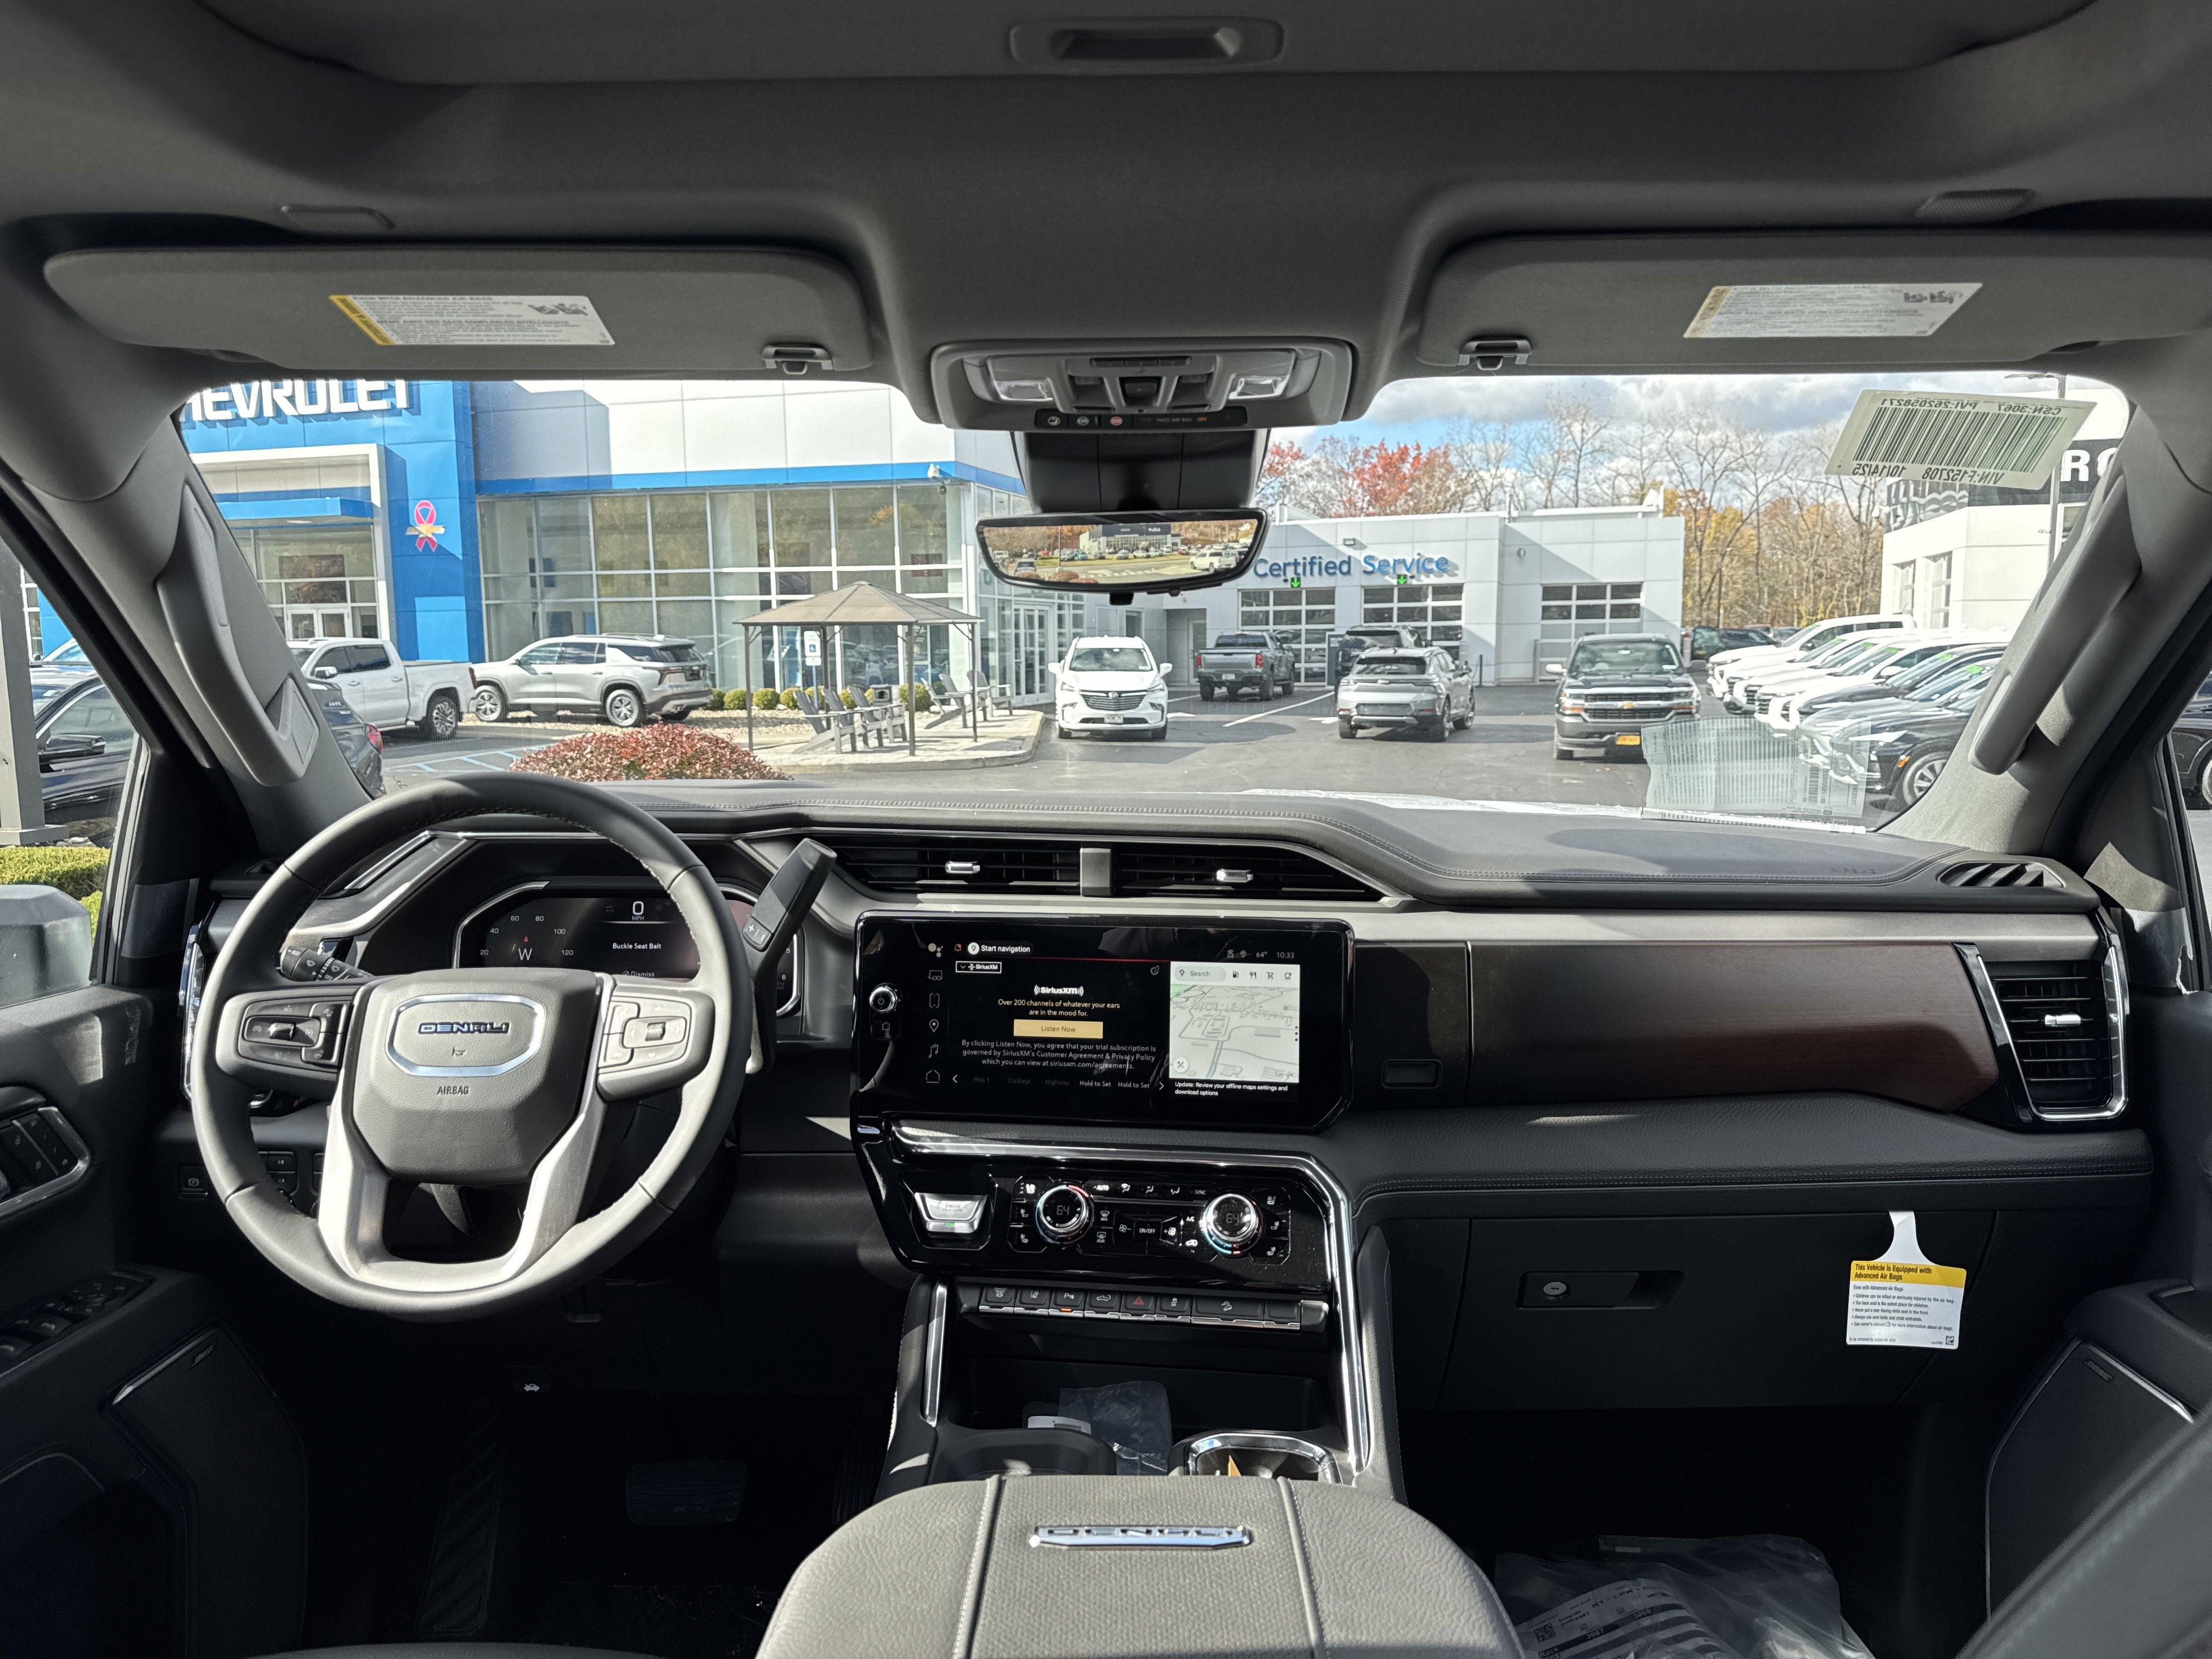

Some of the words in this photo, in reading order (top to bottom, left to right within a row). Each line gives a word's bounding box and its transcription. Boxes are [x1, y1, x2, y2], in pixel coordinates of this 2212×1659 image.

[187, 379, 407, 421] HEVROLET
[1253, 555, 1351, 578] Certified
[1363, 552, 1449, 575] Service
[633, 901, 644, 915] 0
[518, 948, 532, 961] W
[998, 945, 1030, 953] navigation
[419, 1022, 510, 1034] DENALI
[971, 1040, 994, 1048] clicking
[1110, 1044, 1149, 1052] subscription
[1112, 1053, 1134, 1062] Privacy
[1050, 1060, 1135, 1070] siriusxm.com/agreements.
[437, 1086, 469, 1094] AIRBAG
[1057, 1206, 1069, 1216] 64
[1226, 1213, 1239, 1223] 64
